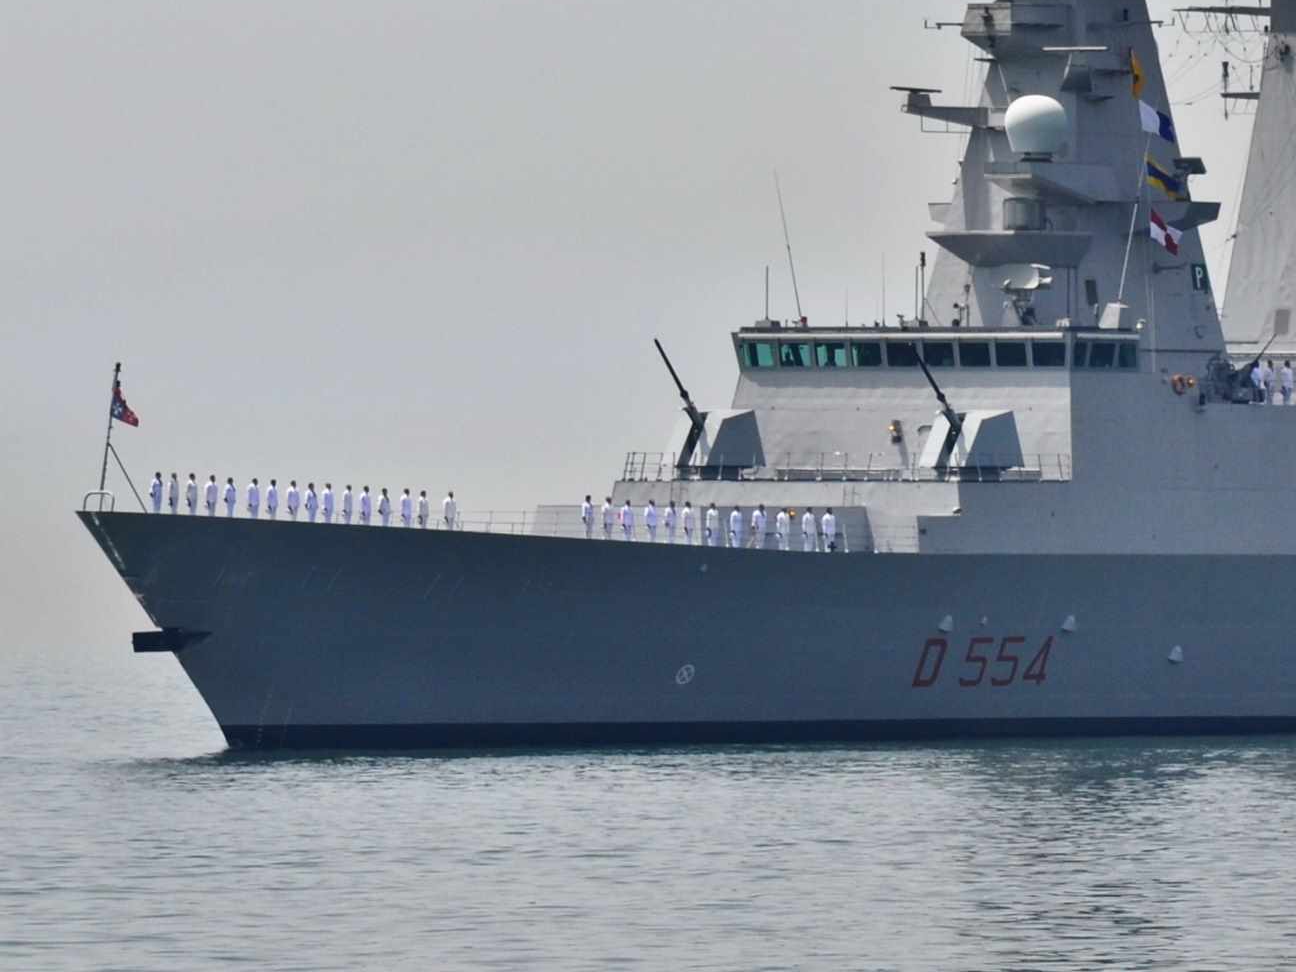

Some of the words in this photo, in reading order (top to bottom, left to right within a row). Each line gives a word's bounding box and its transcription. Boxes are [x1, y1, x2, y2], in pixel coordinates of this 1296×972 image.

[1195, 267, 1204, 289] P
[912, 638, 947, 687] D
[958, 635, 1054, 686] 554
